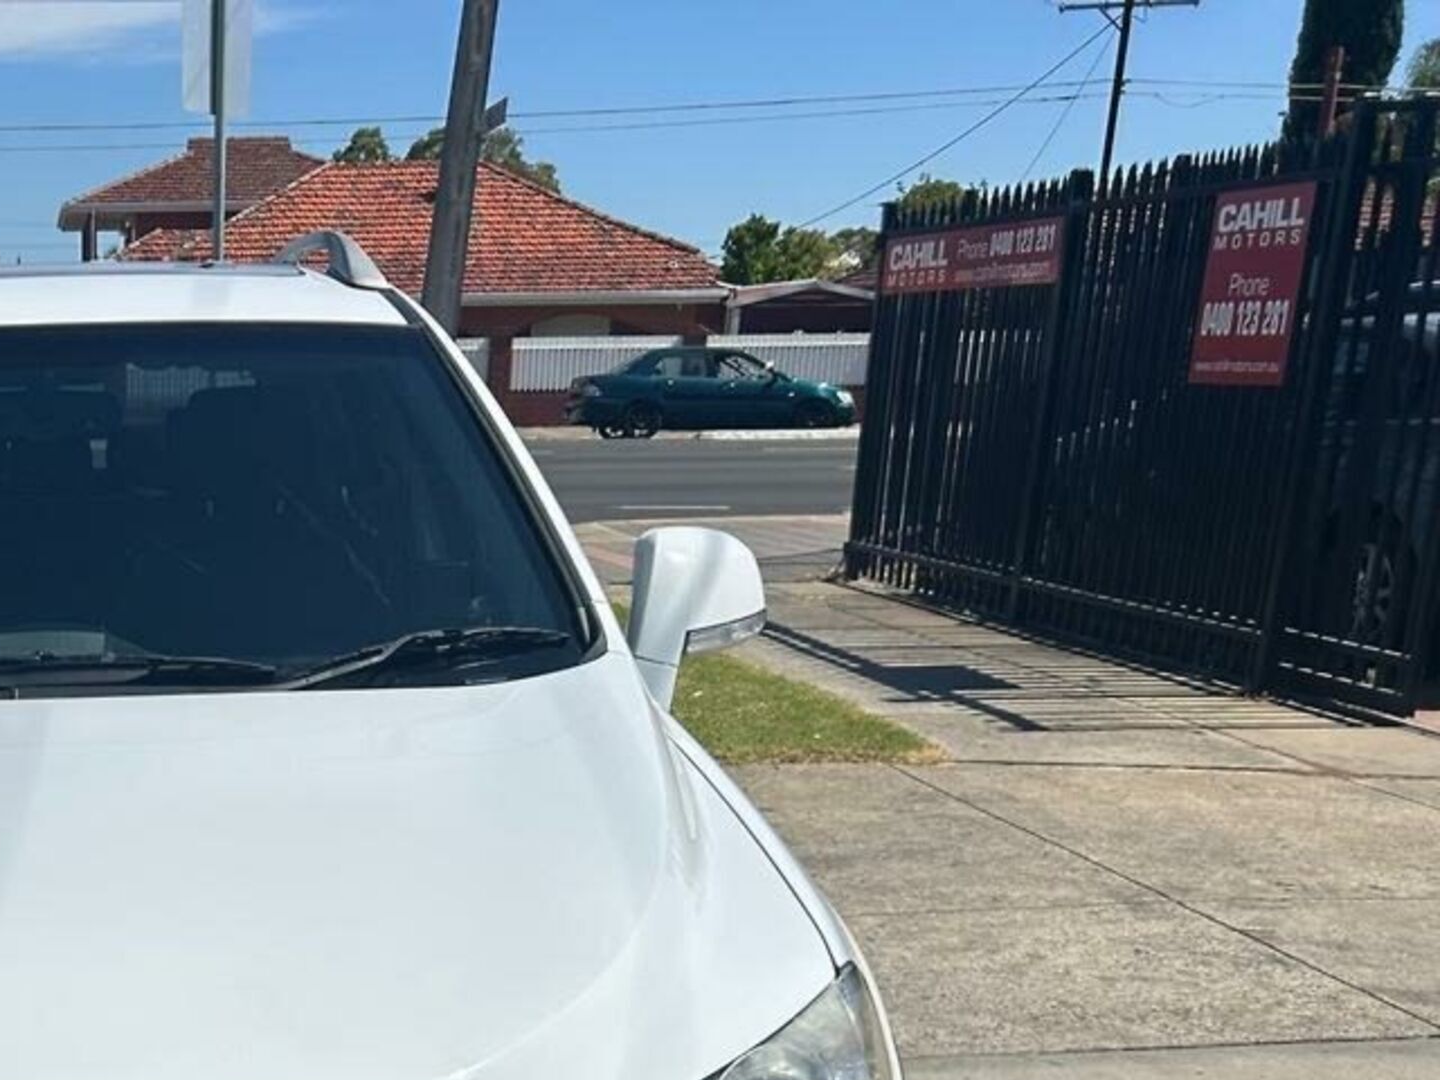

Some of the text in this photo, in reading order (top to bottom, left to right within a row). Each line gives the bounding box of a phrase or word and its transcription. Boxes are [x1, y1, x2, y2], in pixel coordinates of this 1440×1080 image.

[1218, 197, 1305, 233] CAHILL
[956, 238, 989, 260] Phone
[1213, 228, 1302, 250] MOTORS
[889, 239, 948, 271] CAHILL
[887, 269, 947, 288] MOTORS
[1228, 272, 1270, 297] Phone
[1236, 300, 1262, 336] 123
